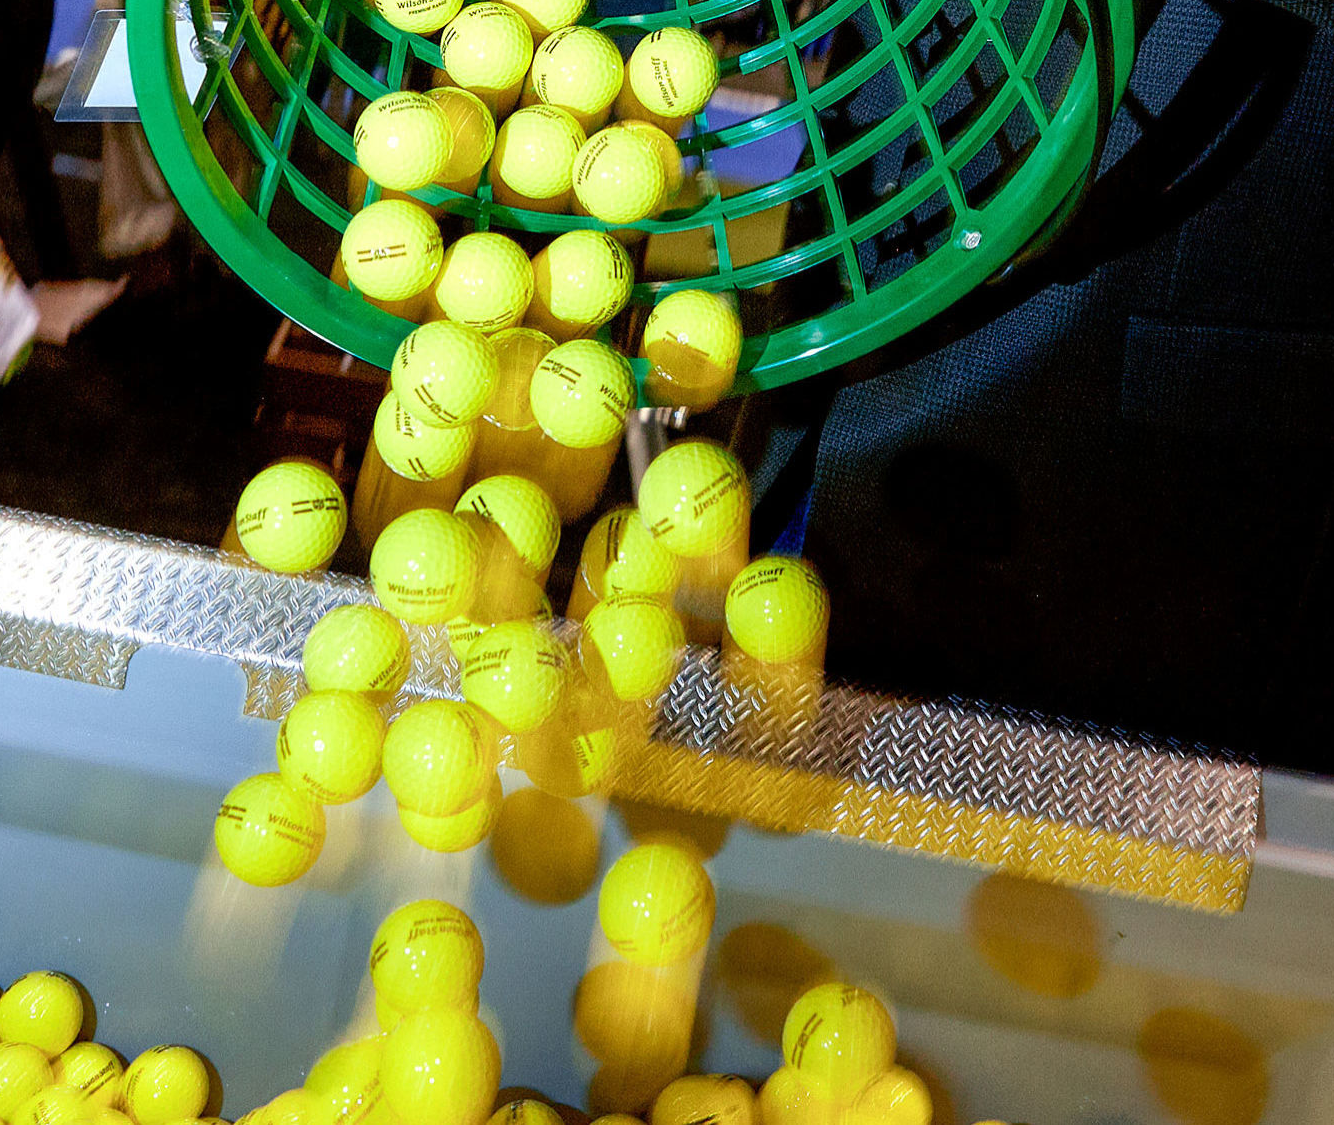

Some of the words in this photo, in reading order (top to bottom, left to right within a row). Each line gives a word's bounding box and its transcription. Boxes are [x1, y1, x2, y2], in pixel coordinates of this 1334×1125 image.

[430, 0, 448, 10] RANGE
[650, 56, 663, 81] Staff
[658, 81, 675, 108] Wilson
[378, 98, 410, 112] Wilson
[577, 154, 590, 185] Wilson
[588, 134, 608, 154] Staff
[757, 566, 785, 577] Staff
[387, 582, 424, 595] Wilson
[426, 582, 455, 596] Staff
[482, 648, 512, 661] Staff
[571, 738, 590, 769] Wilso
[268, 813, 303, 833] Wilson
